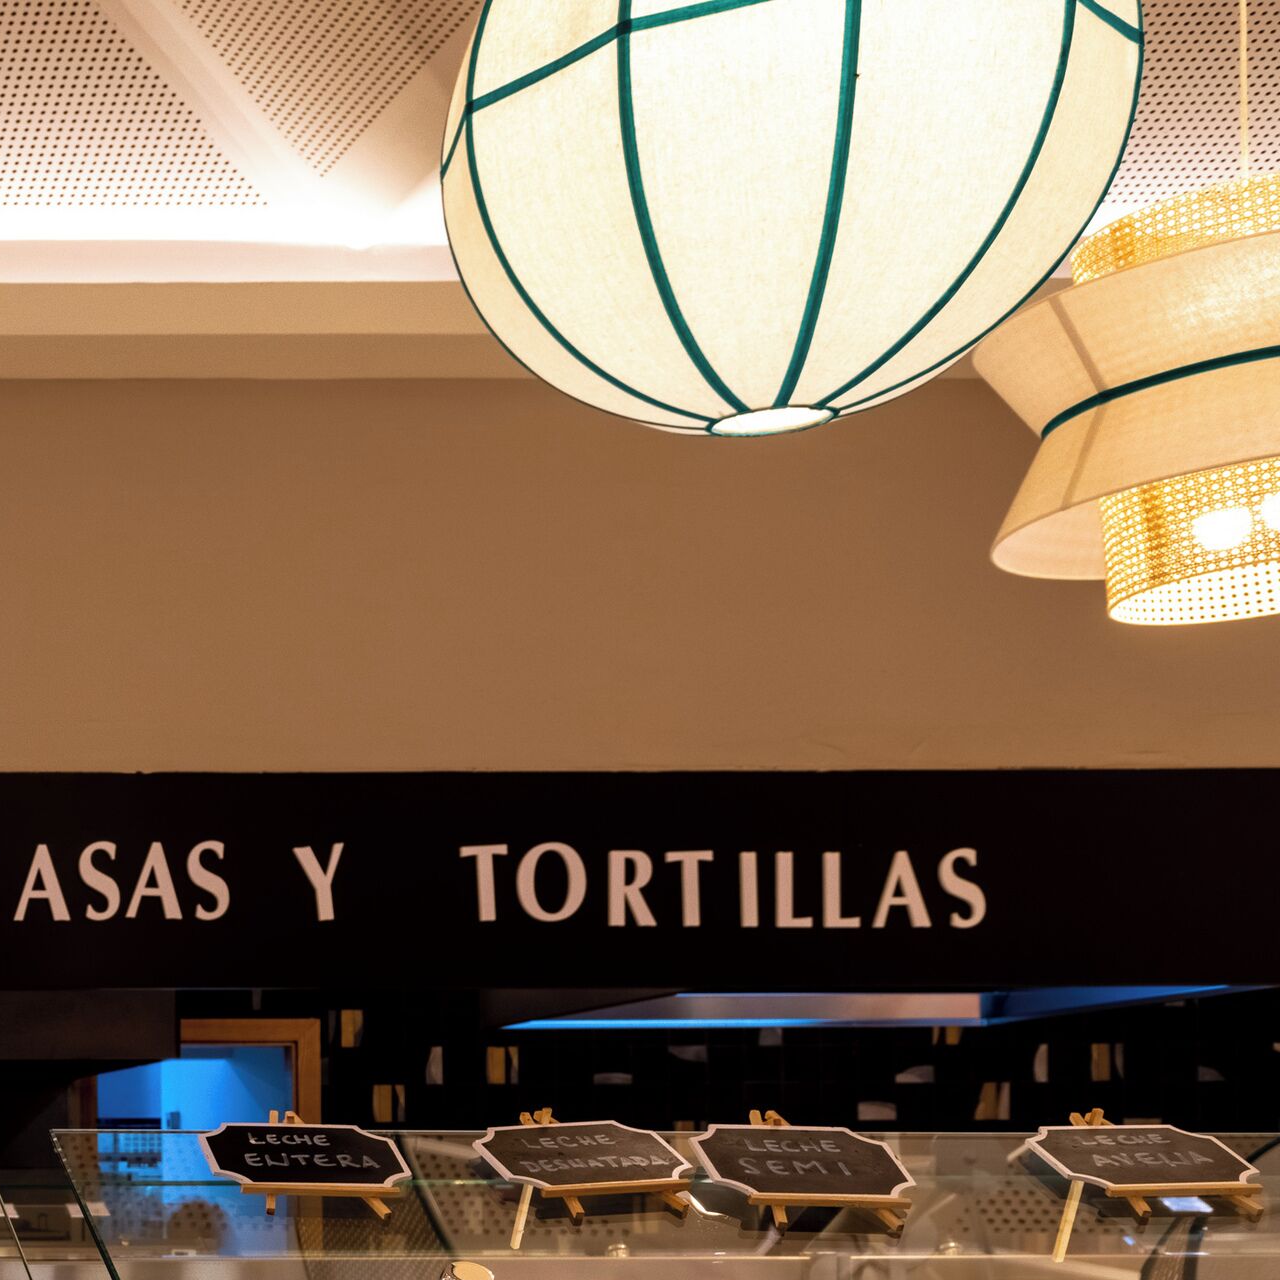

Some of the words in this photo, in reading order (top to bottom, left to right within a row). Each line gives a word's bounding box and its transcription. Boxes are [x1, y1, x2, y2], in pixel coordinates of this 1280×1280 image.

[293, 841, 344, 921] Y
[460, 842, 987, 928] TORTILLAS
[247, 1131, 331, 1147] LECHE
[519, 1132, 617, 1151] LECHE
[742, 1137, 842, 1155] LECHE
[1074, 1132, 1171, 1146] LECHE
[244, 1151, 381, 1171] ENTERA
[737, 1156, 852, 1177] SEMI
